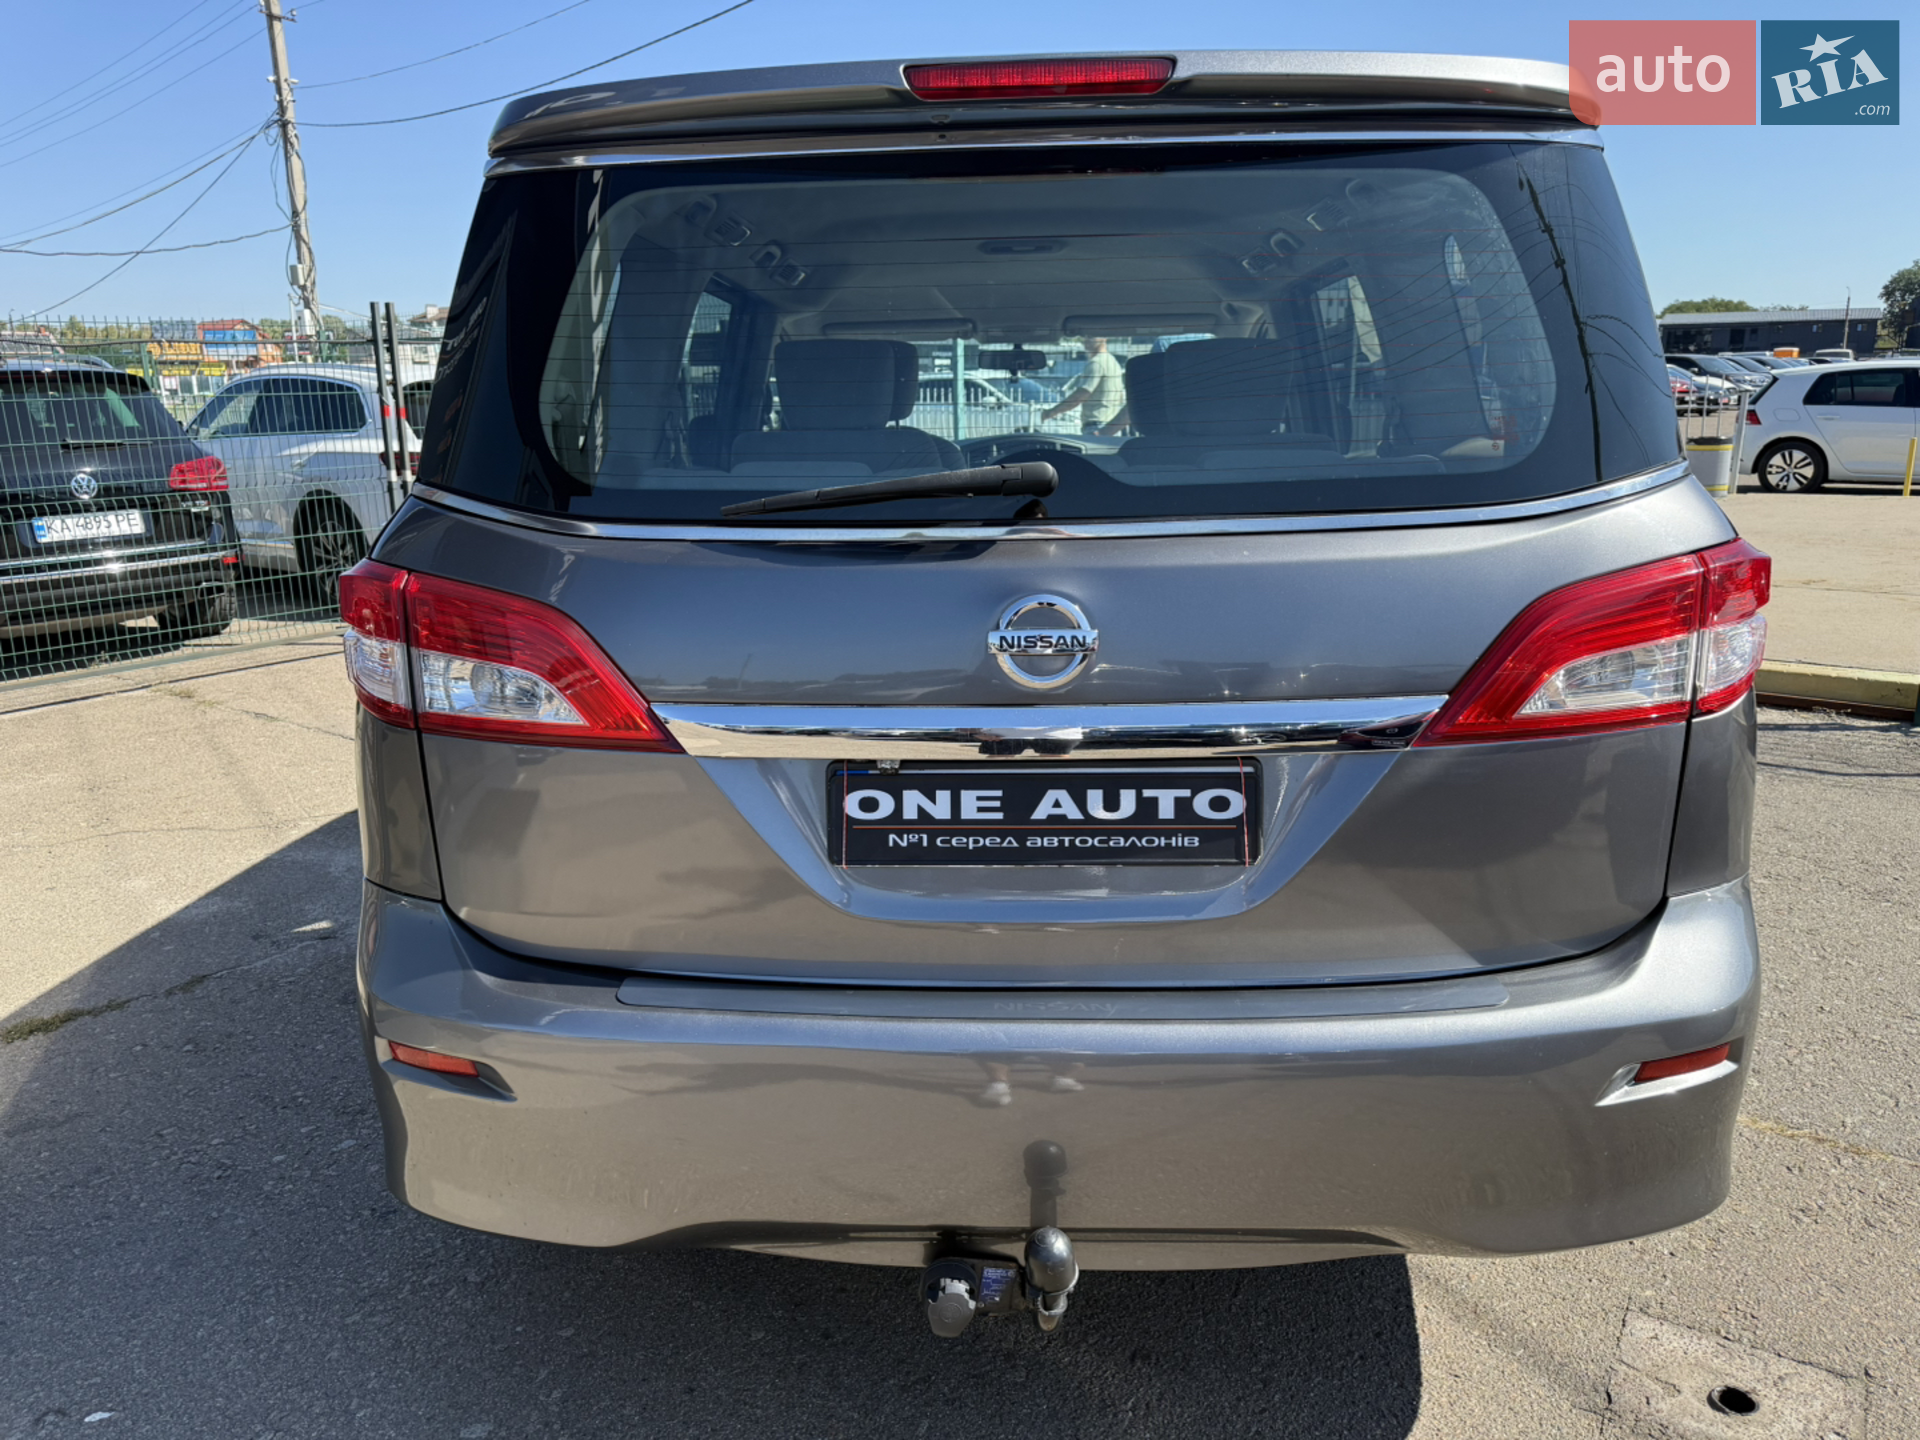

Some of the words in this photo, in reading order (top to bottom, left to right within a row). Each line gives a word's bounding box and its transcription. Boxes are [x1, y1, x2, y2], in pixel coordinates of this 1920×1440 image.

[999, 635, 1086, 650] NISSAN
[844, 788, 1004, 820] ONE
[1030, 788, 1247, 820] AUTO
[936, 836, 1019, 850] серед
[1026, 832, 1200, 848] автосалонів
